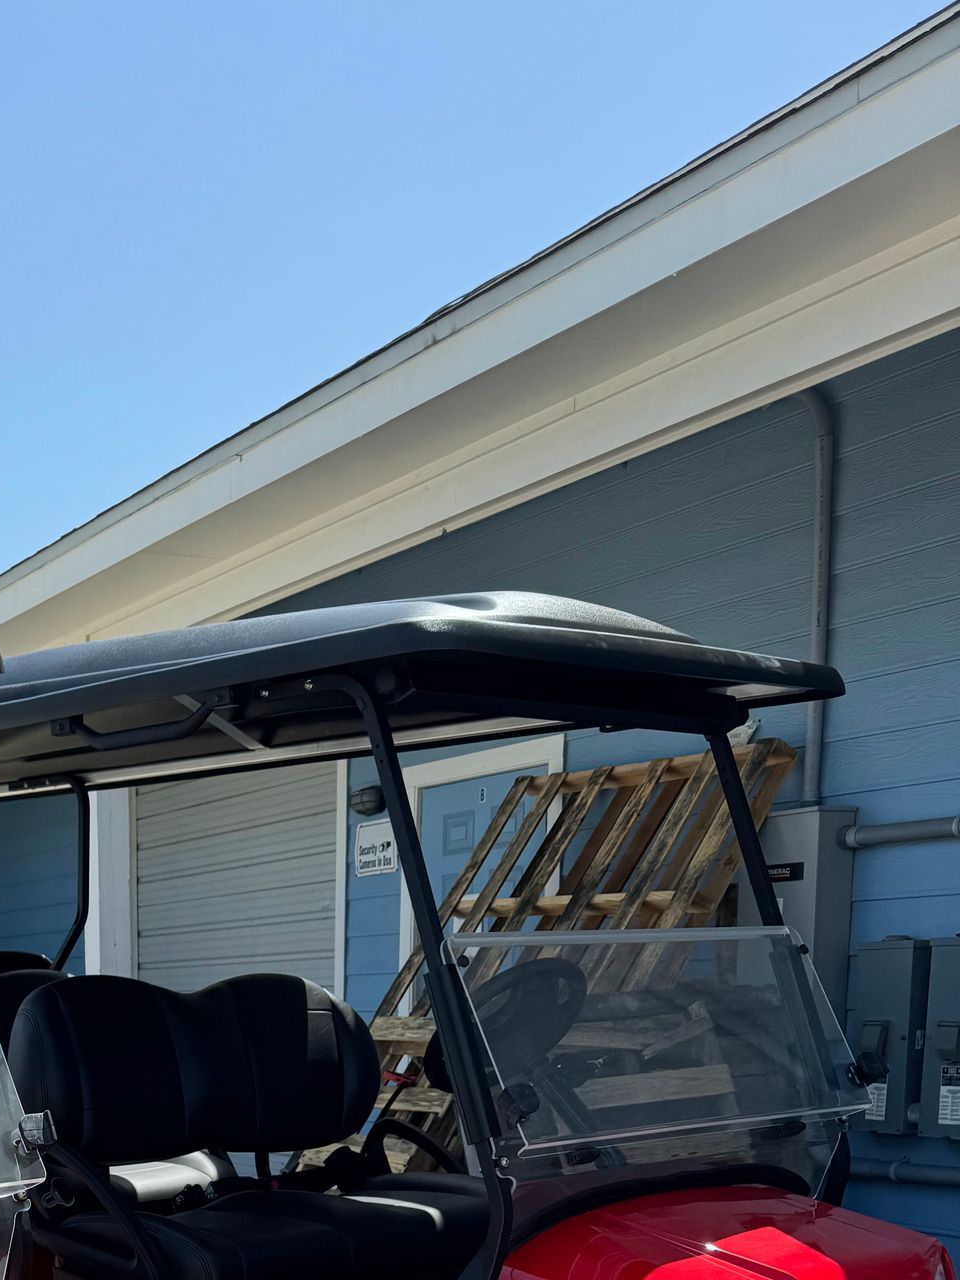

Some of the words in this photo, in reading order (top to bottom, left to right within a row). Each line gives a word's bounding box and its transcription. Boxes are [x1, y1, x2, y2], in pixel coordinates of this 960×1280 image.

[359, 844, 378, 857] Security
[359, 858, 377, 870] Cameras
[383, 854, 392, 867] Use
